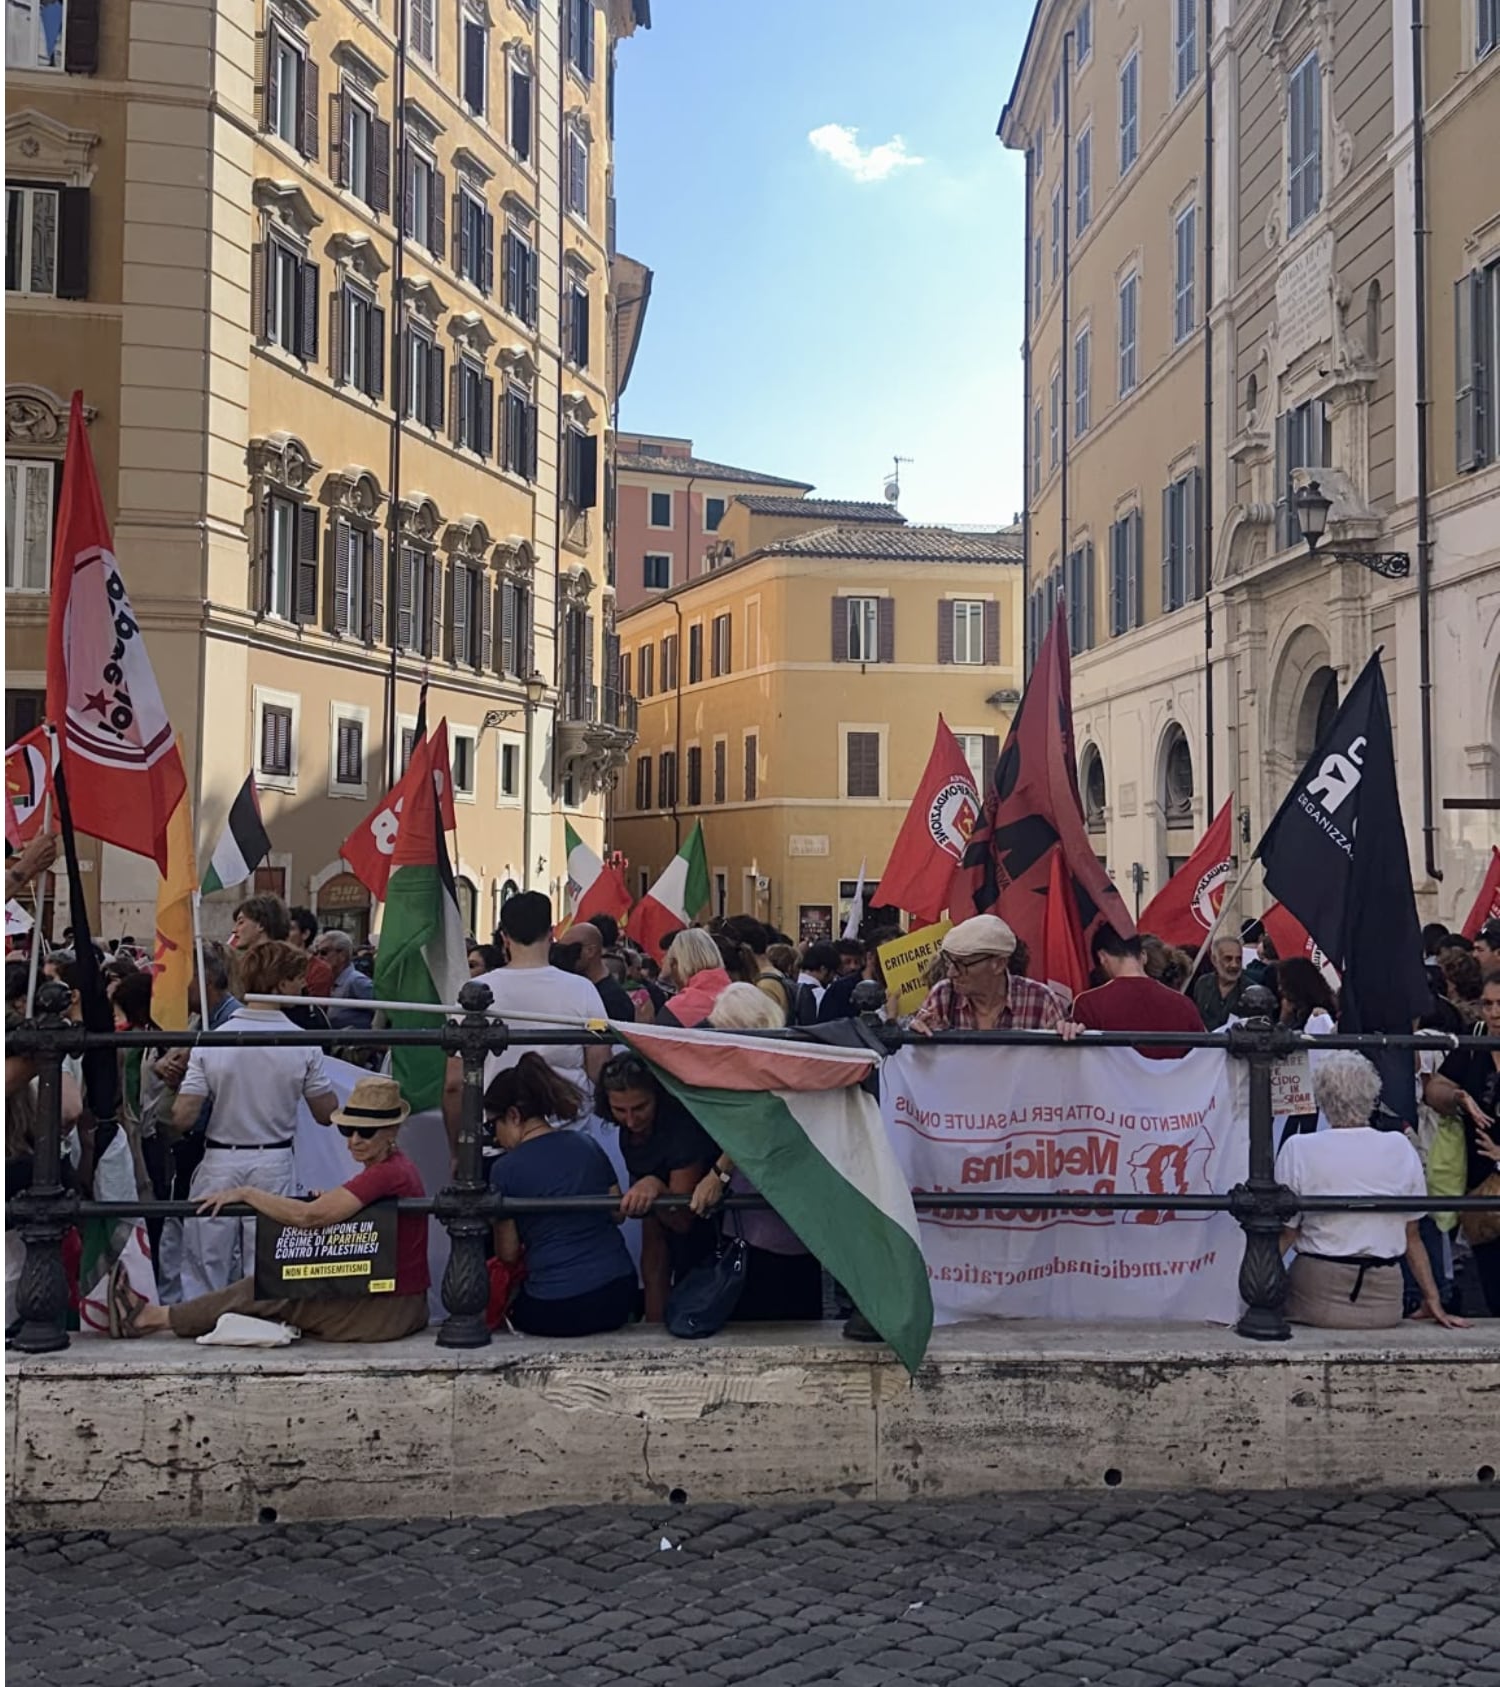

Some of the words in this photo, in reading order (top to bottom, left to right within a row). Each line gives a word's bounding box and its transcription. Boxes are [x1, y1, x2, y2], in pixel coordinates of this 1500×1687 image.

[1298, 793, 1355, 861] ORGANIZZA
[884, 943, 933, 971] CRITICARE
[901, 977, 926, 995] ANTI
[321, 1222, 359, 1235] IMPONE
[360, 1221, 374, 1232] UN
[276, 1236, 312, 1249] REGIME
[314, 1235, 325, 1246] DI
[326, 1231, 378, 1246] APARTHEID
[275, 1247, 312, 1259] CONTRO
[314, 1247, 320, 1257] I
[320, 1242, 380, 1257] PALESTINESI
[285, 1267, 302, 1277] NON
[310, 1262, 369, 1276] ANTISEMITISMO
